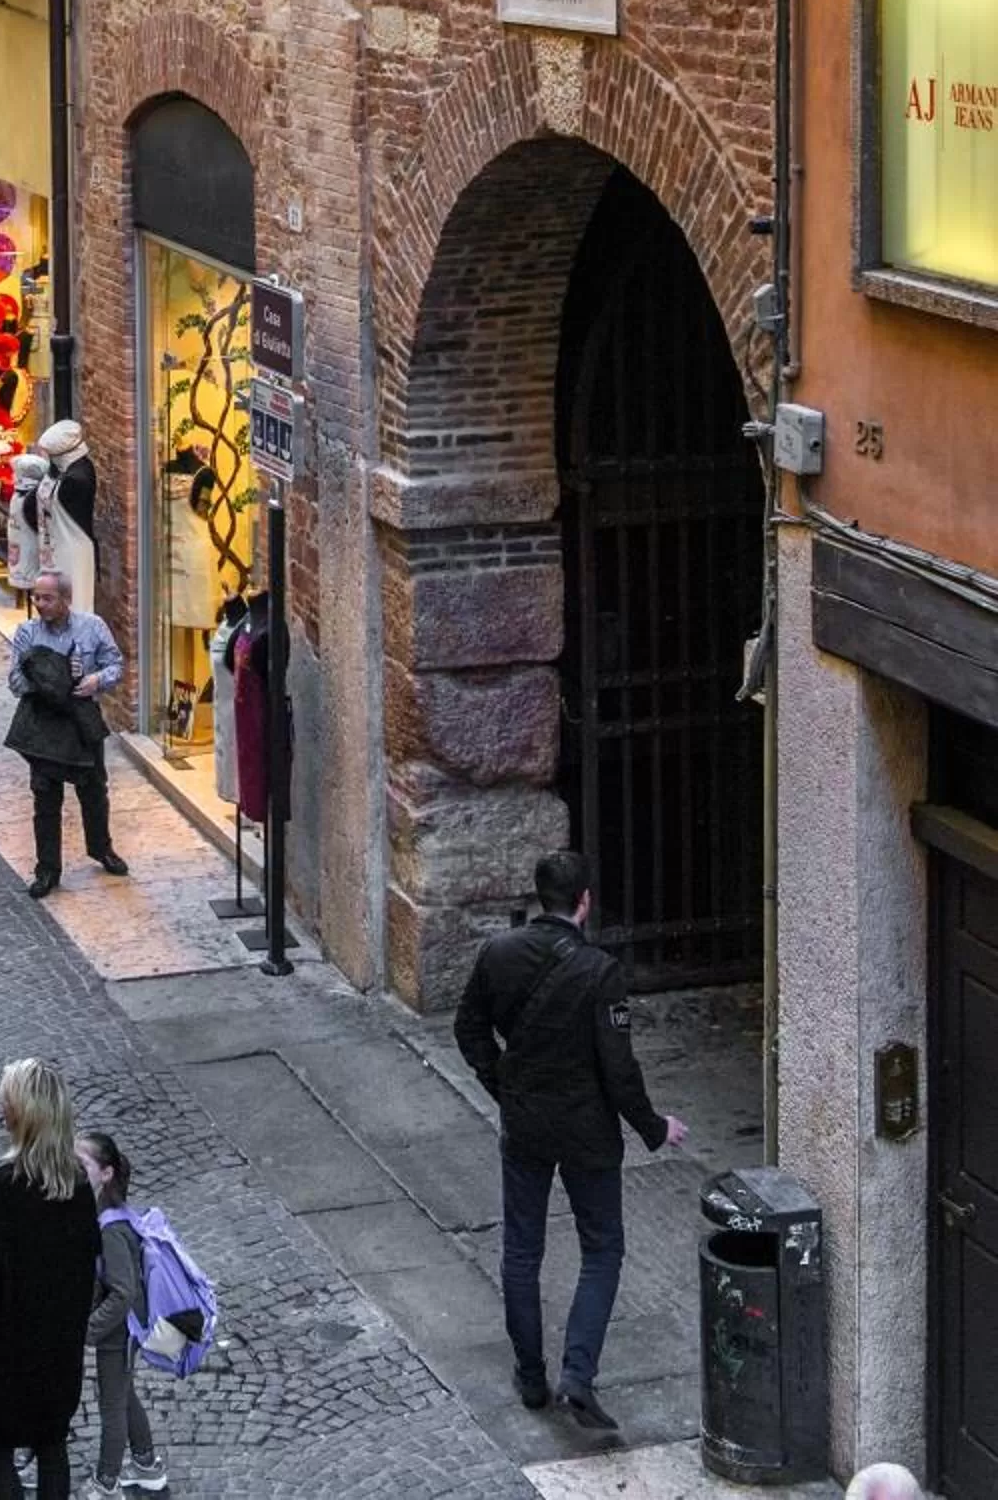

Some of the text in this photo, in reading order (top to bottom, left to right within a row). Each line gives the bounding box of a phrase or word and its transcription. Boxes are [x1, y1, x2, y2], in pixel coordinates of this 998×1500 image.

[905, 77, 935, 122] AJ
[954, 105, 993, 132] JEANS
[856, 421, 883, 461] 25
